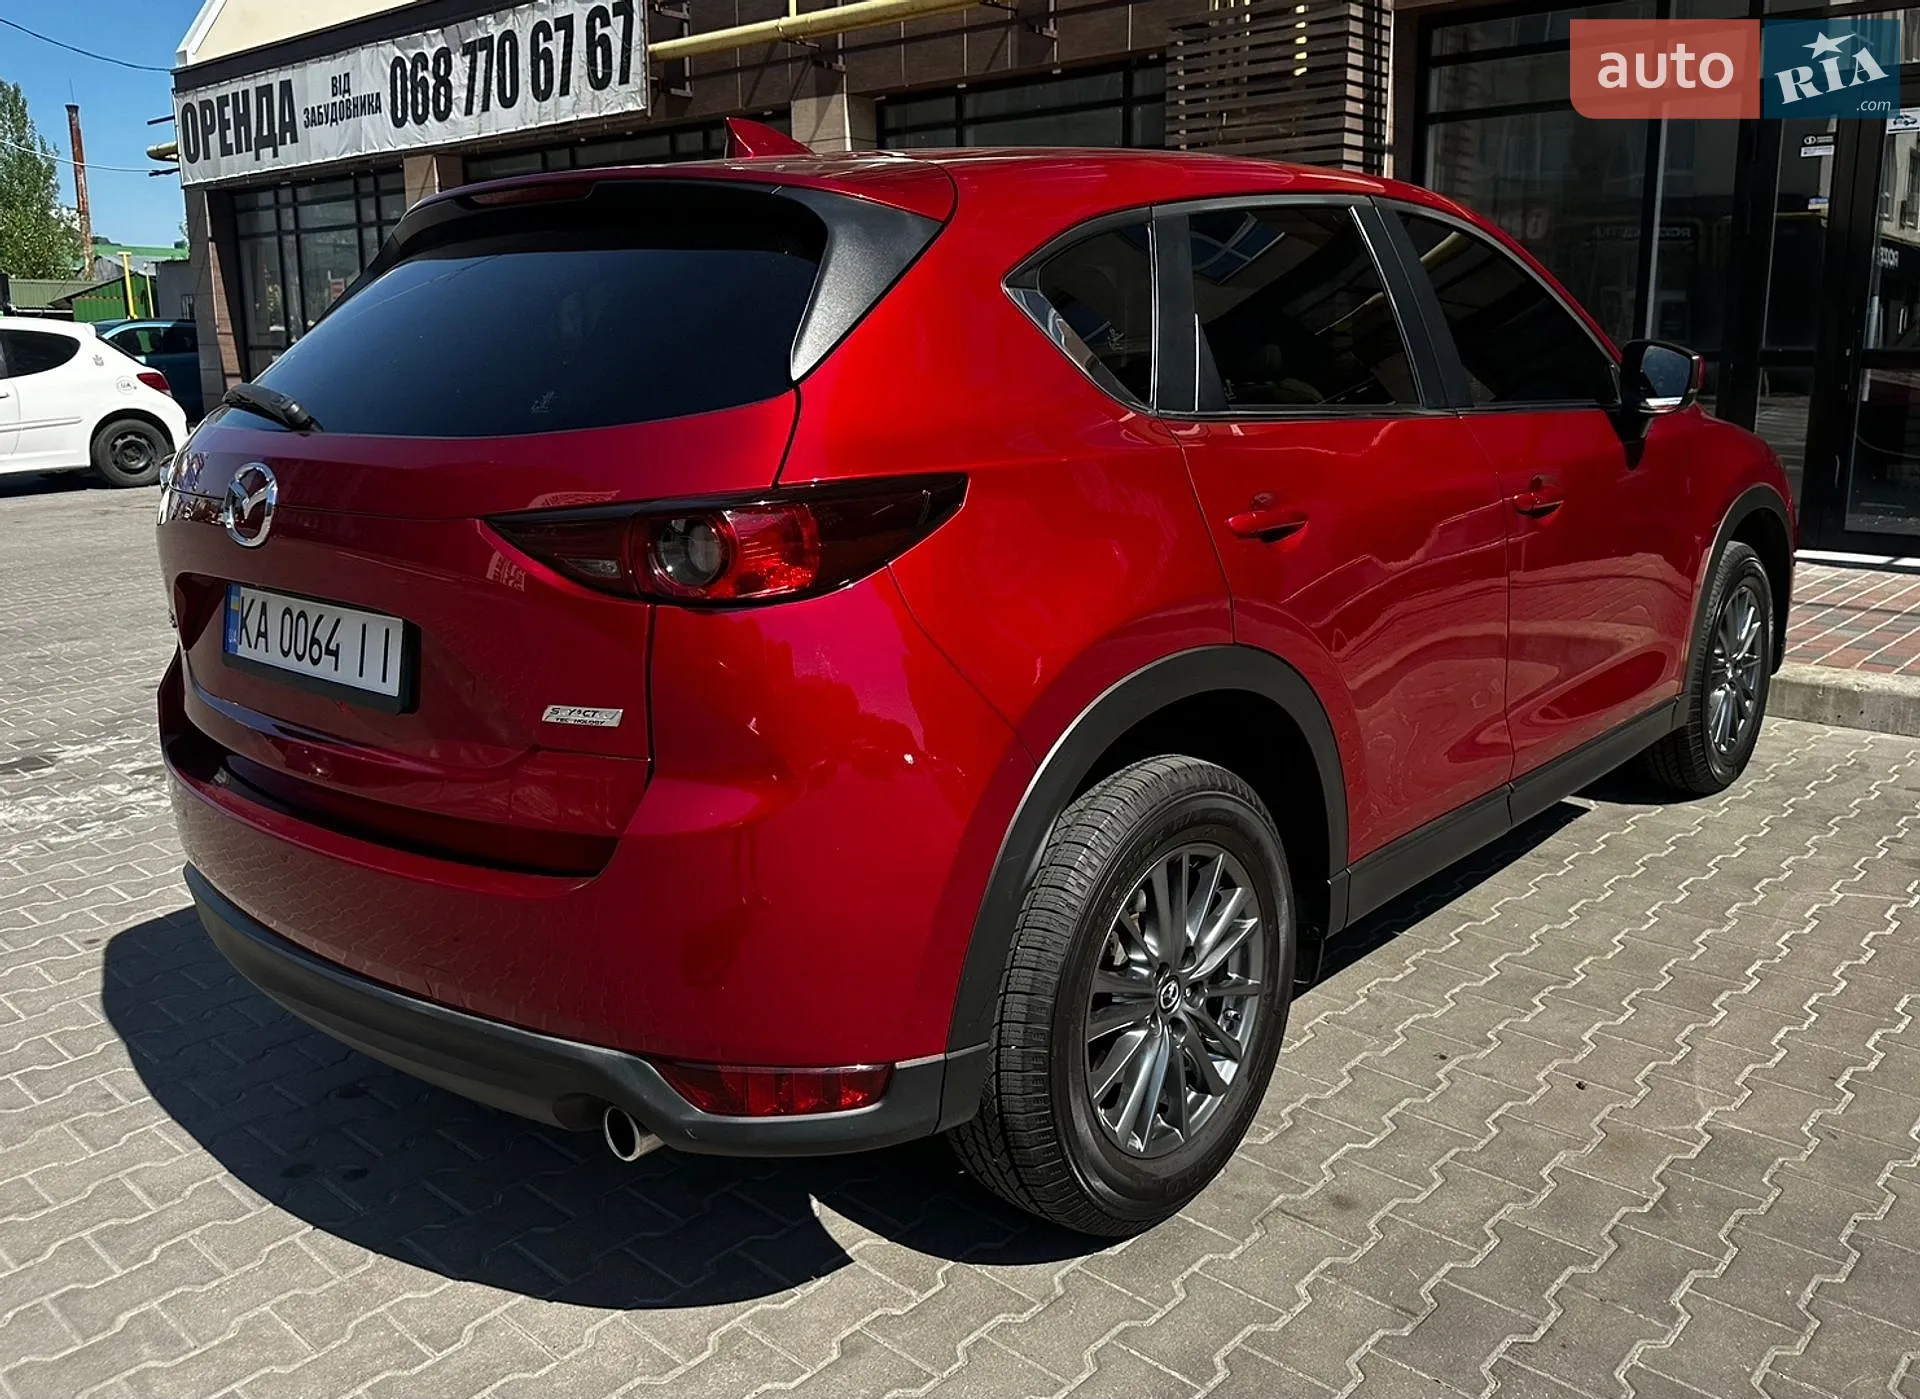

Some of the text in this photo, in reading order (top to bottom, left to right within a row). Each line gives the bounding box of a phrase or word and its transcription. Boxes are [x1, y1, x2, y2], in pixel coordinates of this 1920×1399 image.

[331, 72, 351, 98] ВІД
[389, 1, 634, 128] 068 770 67 67
[181, 79, 299, 164] ОРЕНДА
[303, 91, 382, 129] ЗАБУДОВНИКА
[239, 596, 269, 653] KA
[280, 607, 341, 671] 0064
